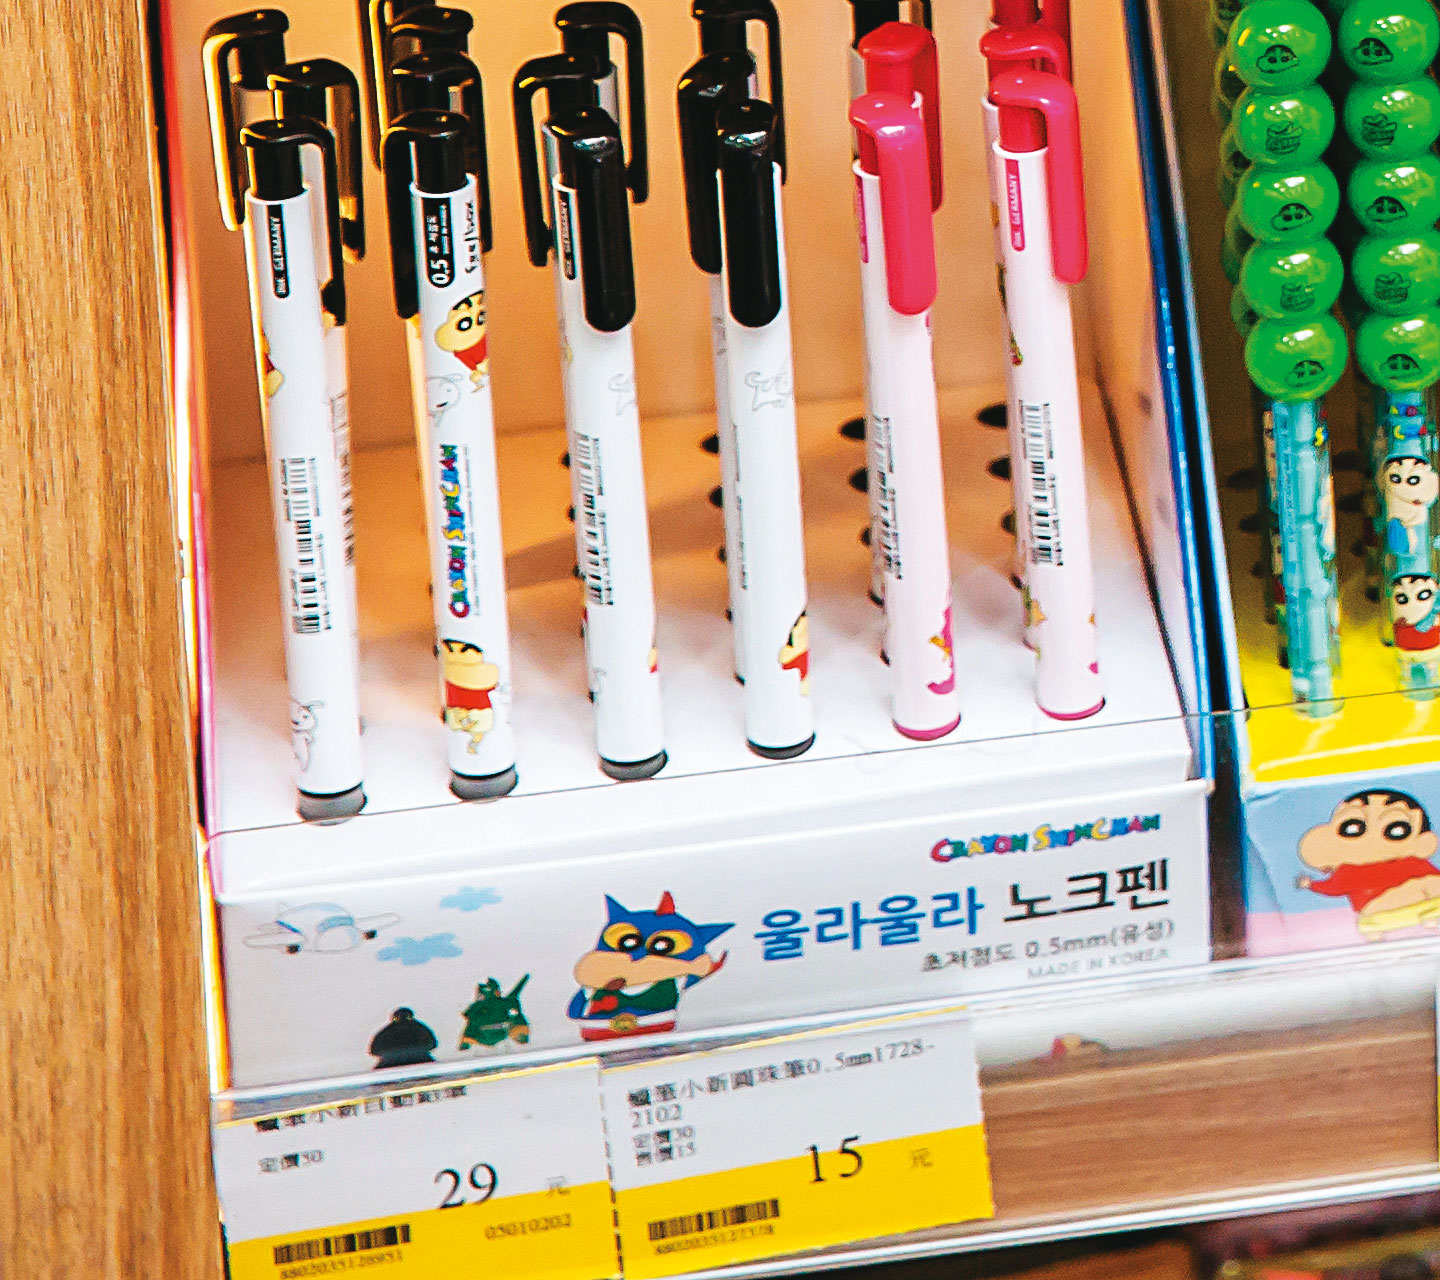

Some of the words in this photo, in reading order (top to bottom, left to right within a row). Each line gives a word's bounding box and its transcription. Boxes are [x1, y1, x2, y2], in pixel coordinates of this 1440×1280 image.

[754, 886, 985, 963] 울라울라
[1003, 856, 1171, 925] 노크펜
[804, 1135, 864, 1184] 15
[434, 1161, 499, 1212] 29
